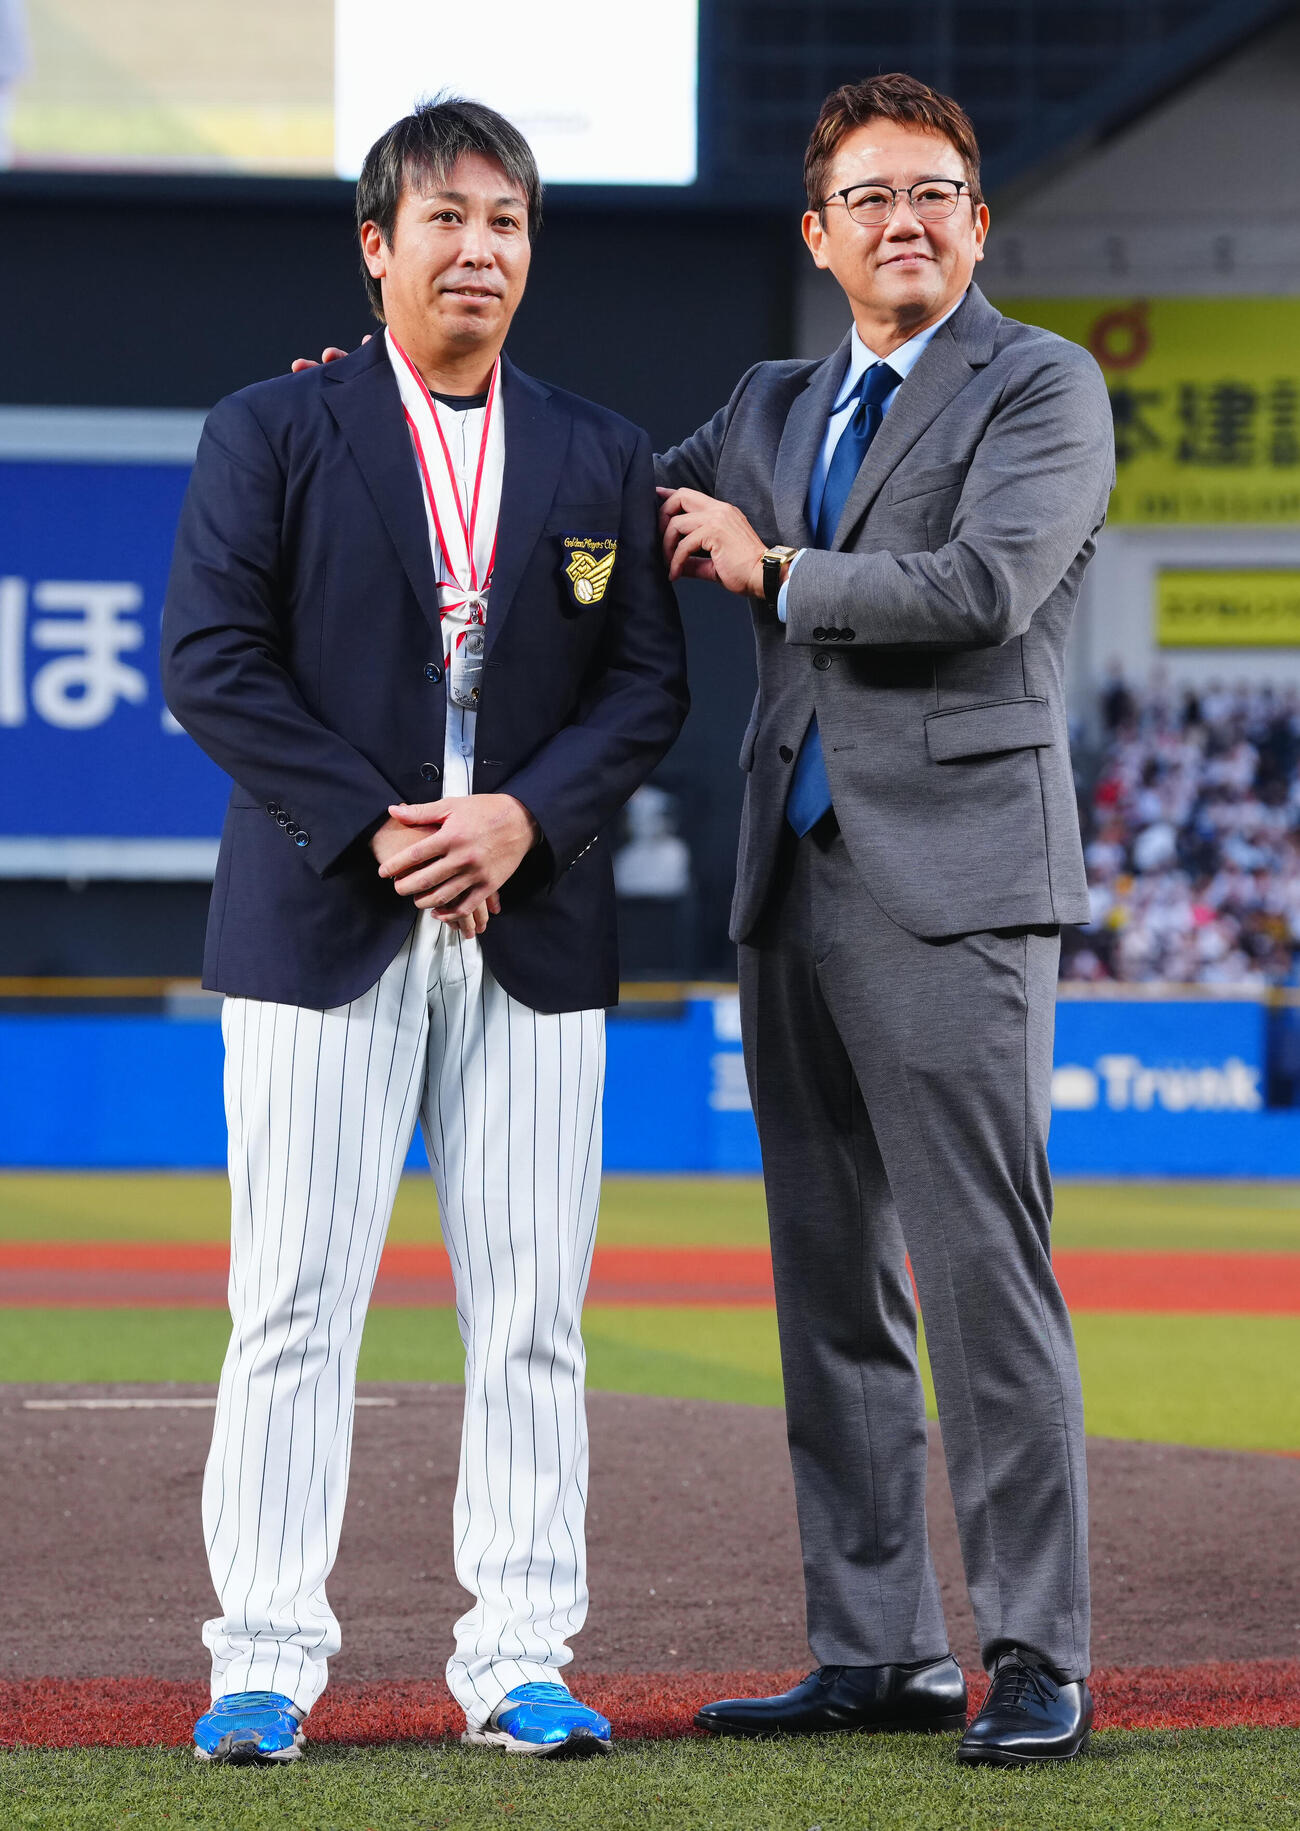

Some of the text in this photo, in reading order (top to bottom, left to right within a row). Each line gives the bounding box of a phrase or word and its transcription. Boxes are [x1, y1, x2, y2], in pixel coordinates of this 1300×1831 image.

[565, 537, 617, 551] Golden Players Club
[1096, 1055, 1262, 1112] Trunk
